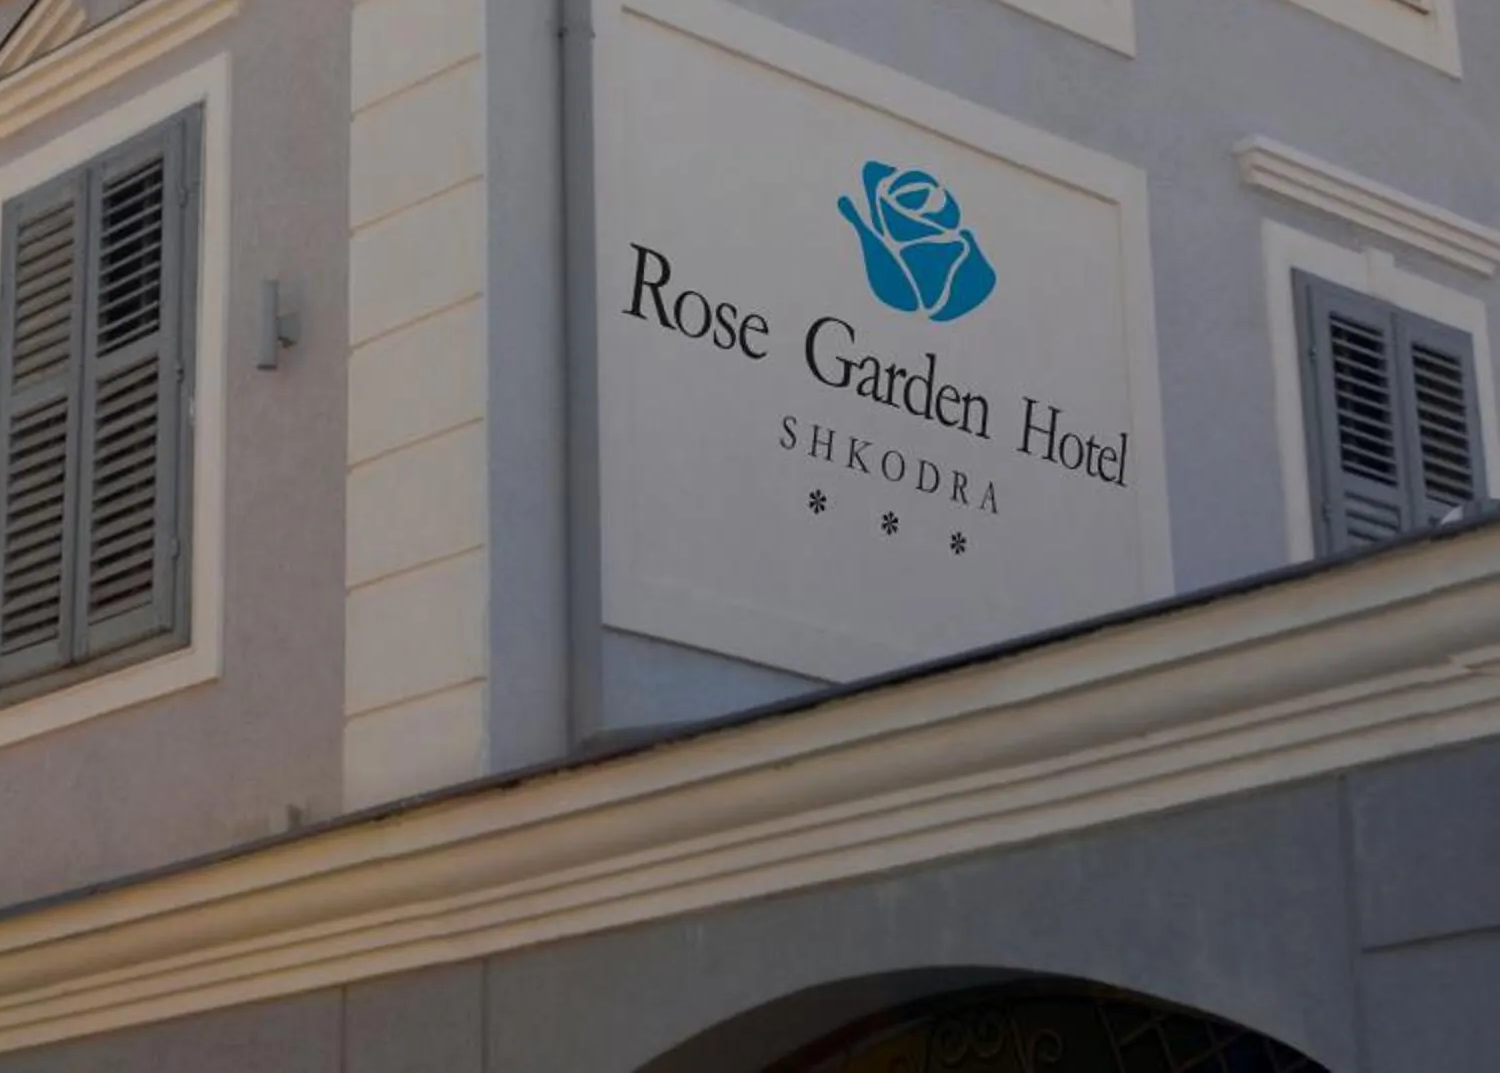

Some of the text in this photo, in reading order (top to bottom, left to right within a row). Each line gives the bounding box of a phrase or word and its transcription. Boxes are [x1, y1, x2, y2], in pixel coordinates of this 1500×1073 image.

[622, 242, 1129, 487] Rose Garden Hotel
[780, 416, 999, 514] SHKODRA
